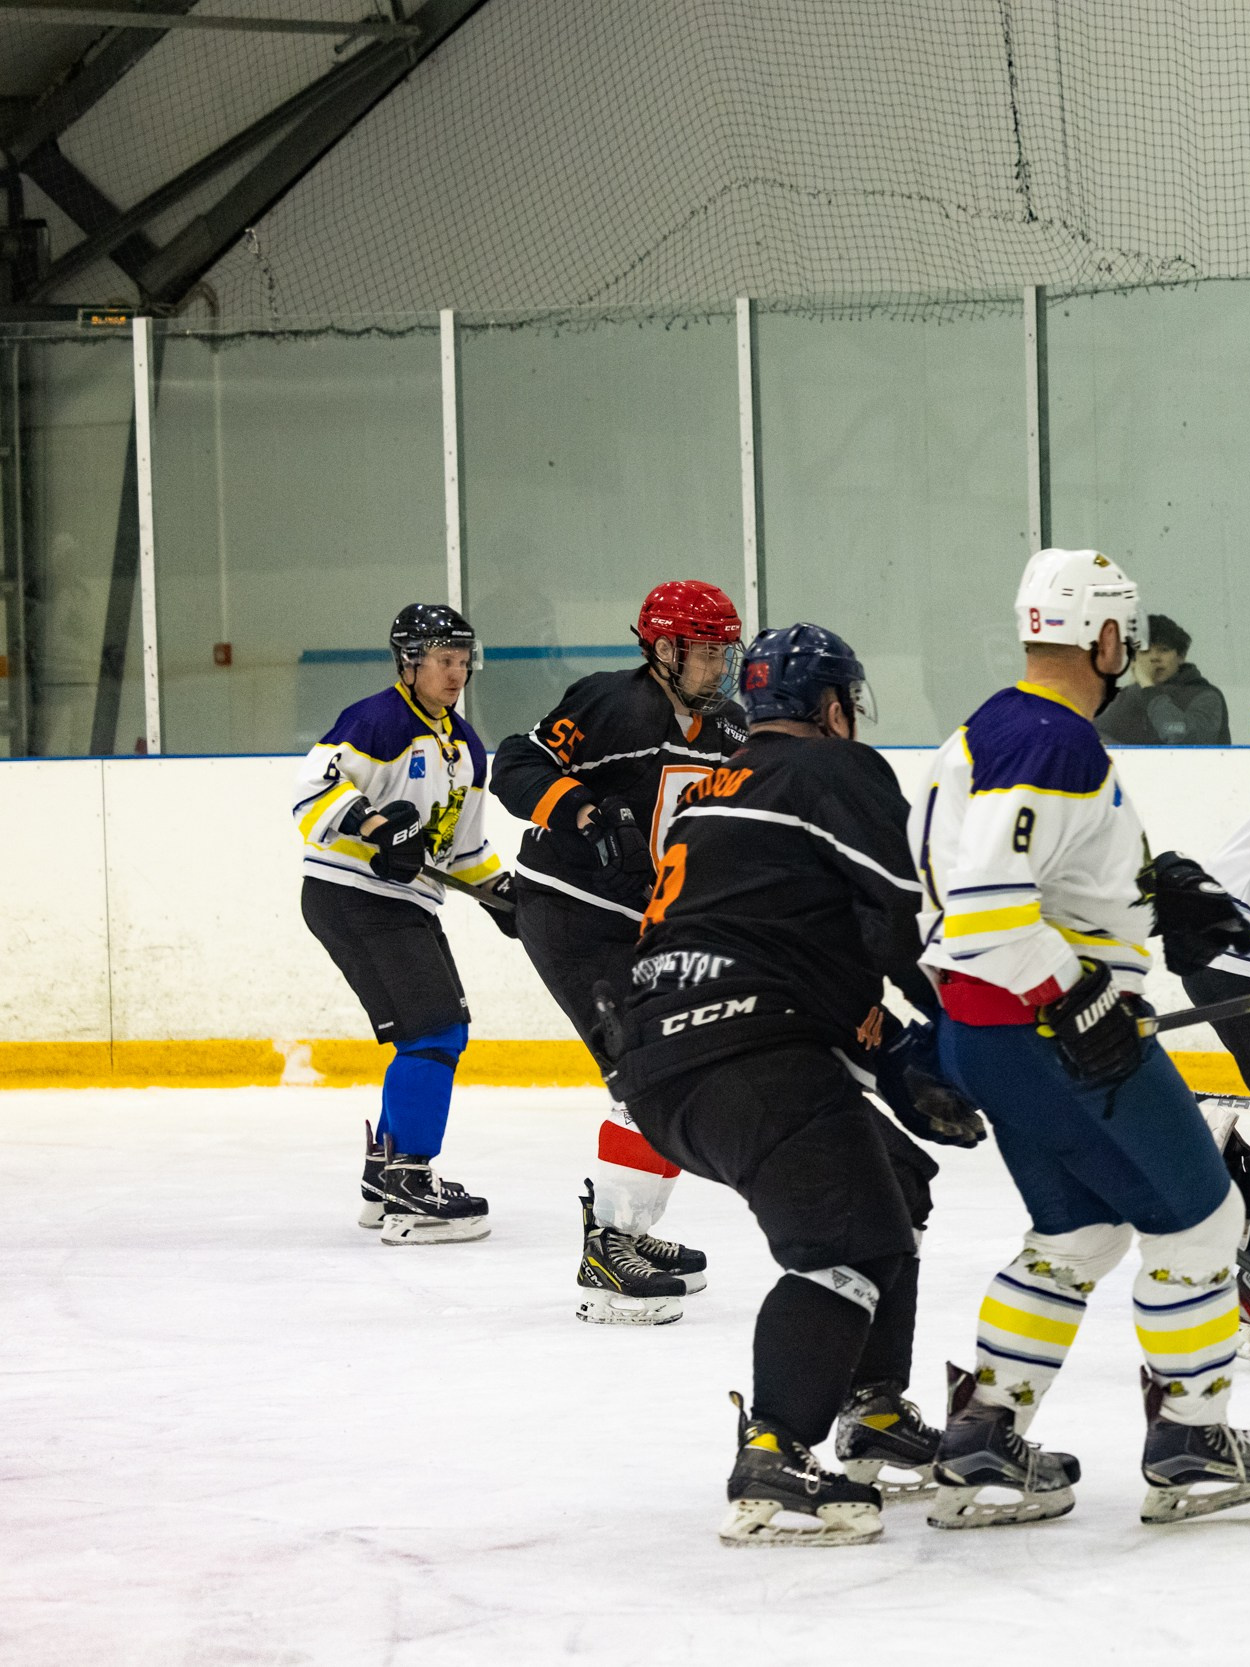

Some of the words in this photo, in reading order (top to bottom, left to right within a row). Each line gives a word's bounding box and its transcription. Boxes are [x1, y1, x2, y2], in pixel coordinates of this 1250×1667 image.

[651, 617, 673, 626] CCM
[1029, 607, 1041, 634] 8
[323, 752, 343, 781] 6
[1012, 805, 1037, 855] 8
[660, 995, 758, 1037] CCM
